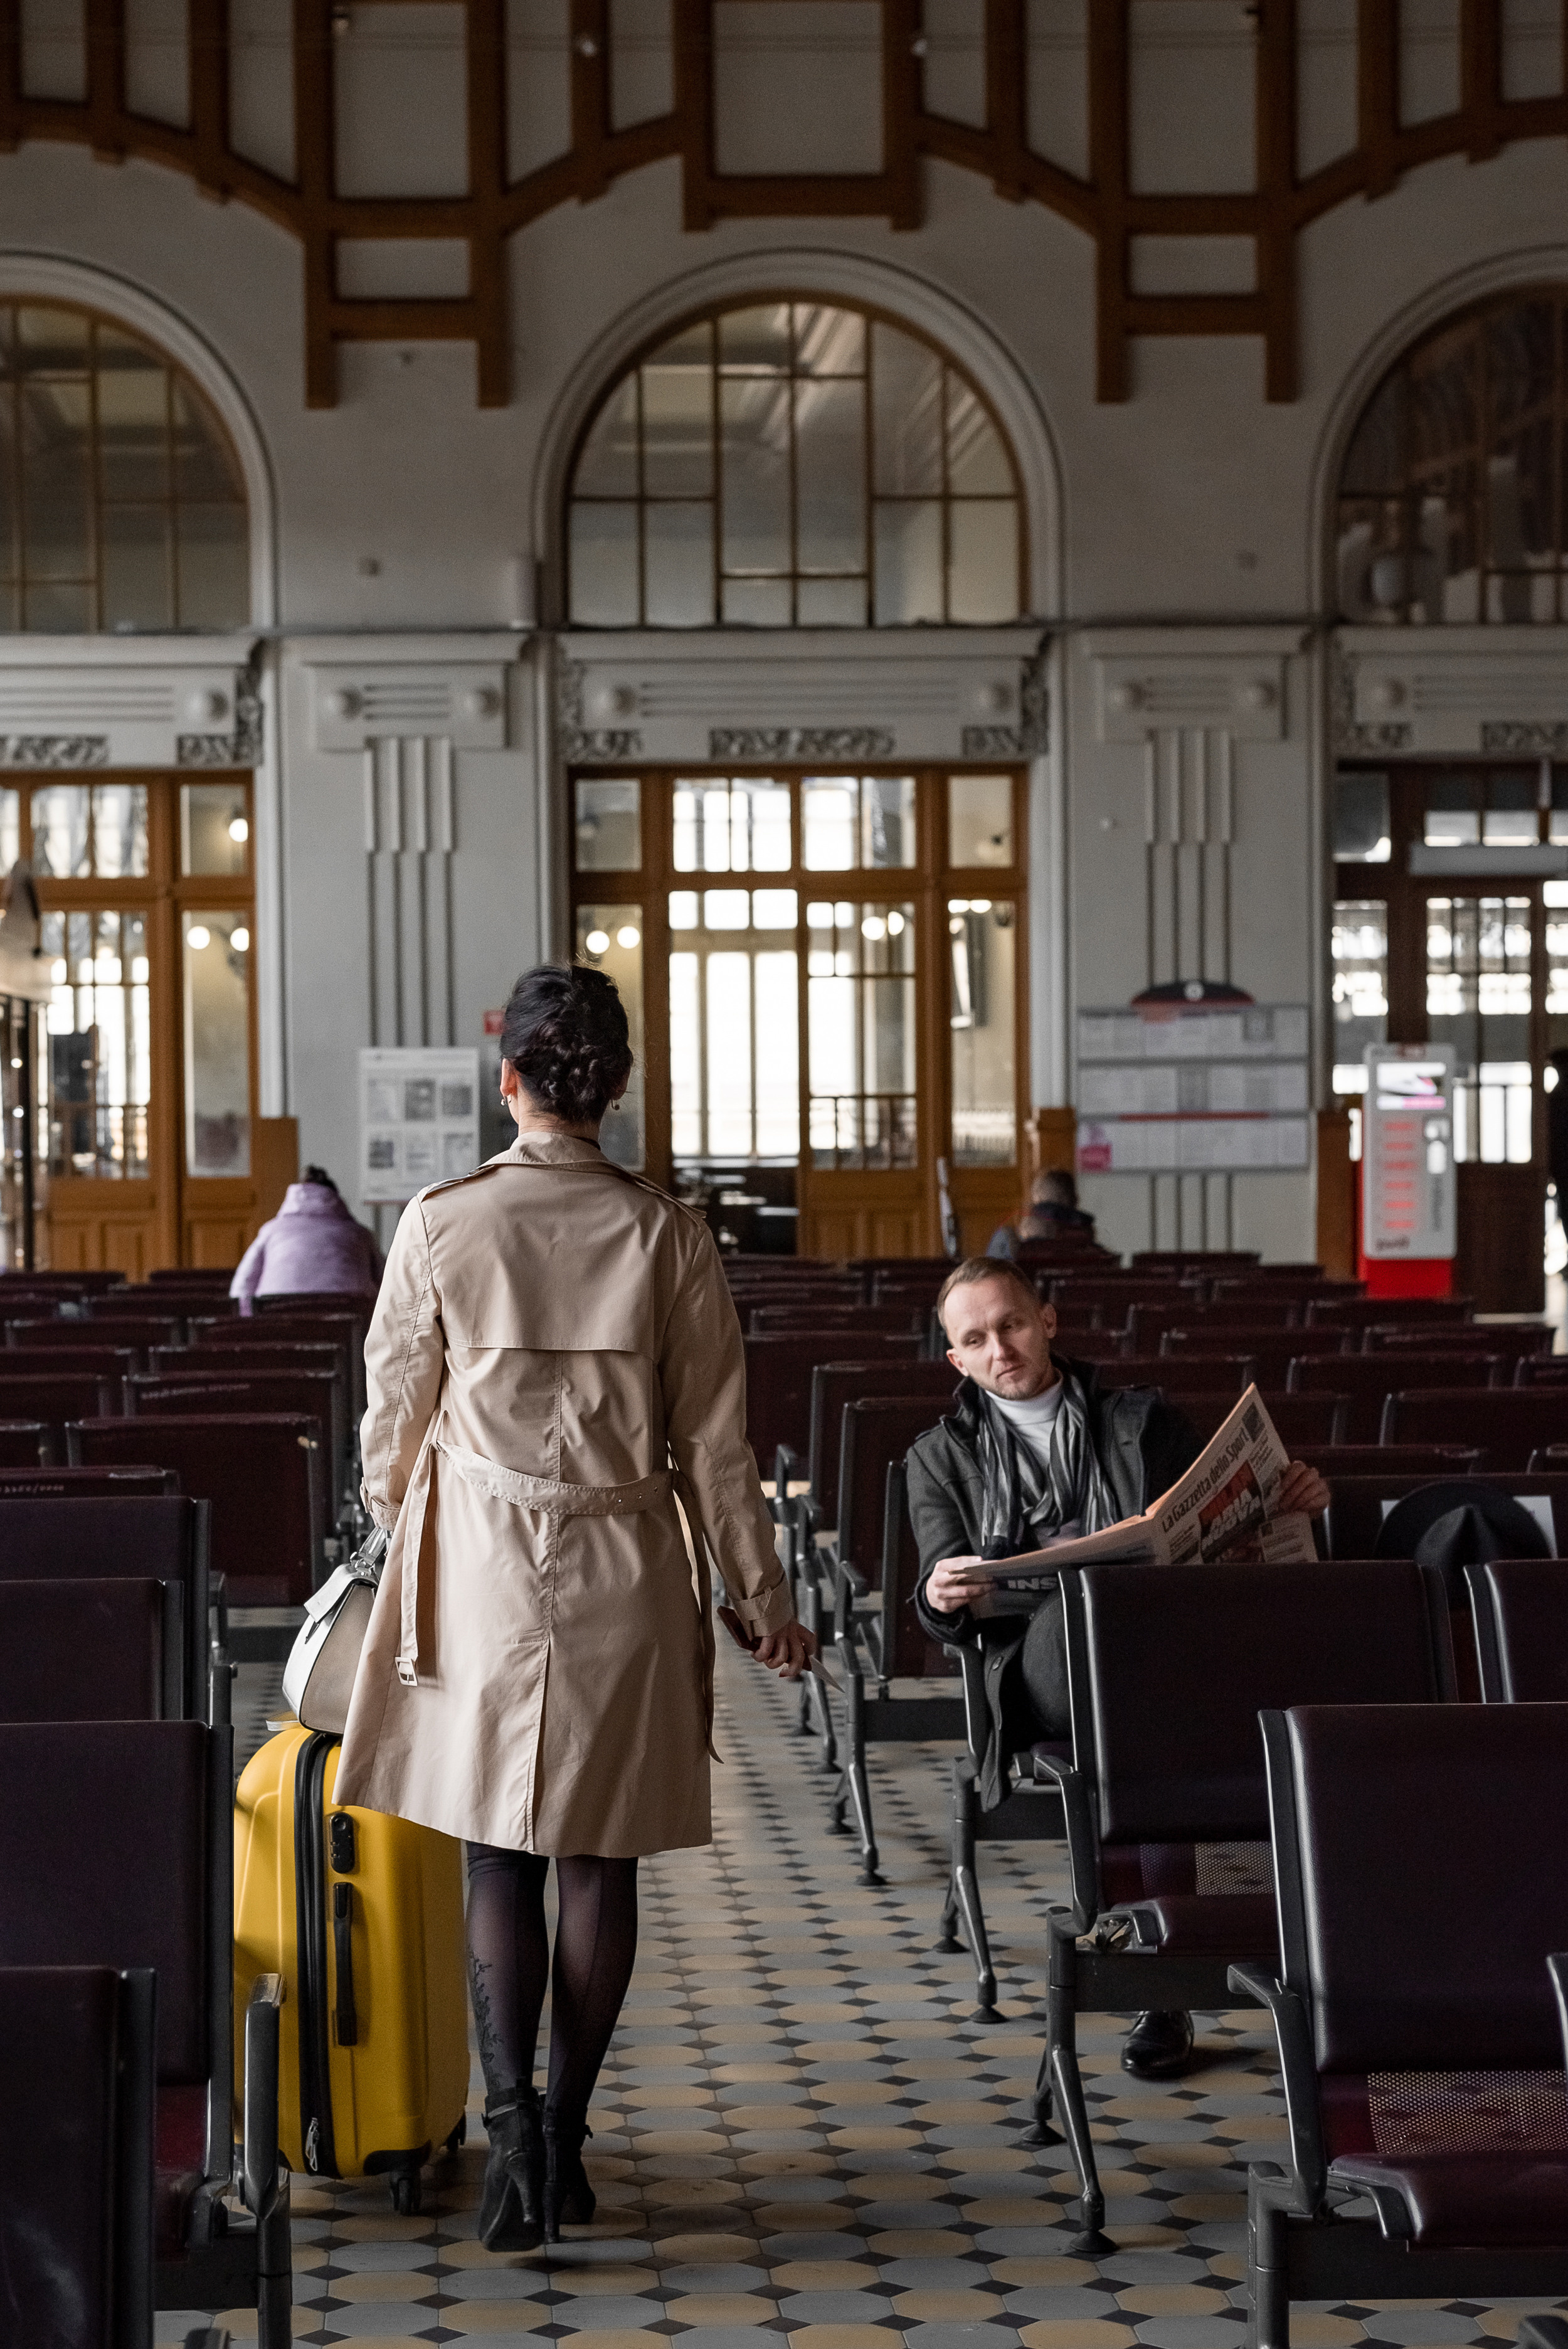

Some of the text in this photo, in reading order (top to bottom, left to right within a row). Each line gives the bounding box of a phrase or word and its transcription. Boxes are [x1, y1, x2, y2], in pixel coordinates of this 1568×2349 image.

[1162, 1514, 1175, 1532] La
[1172, 1477, 1212, 1521] Gazzetta
[1210, 1456, 1230, 1484] dello
[1226, 1428, 1250, 1462] Sport
